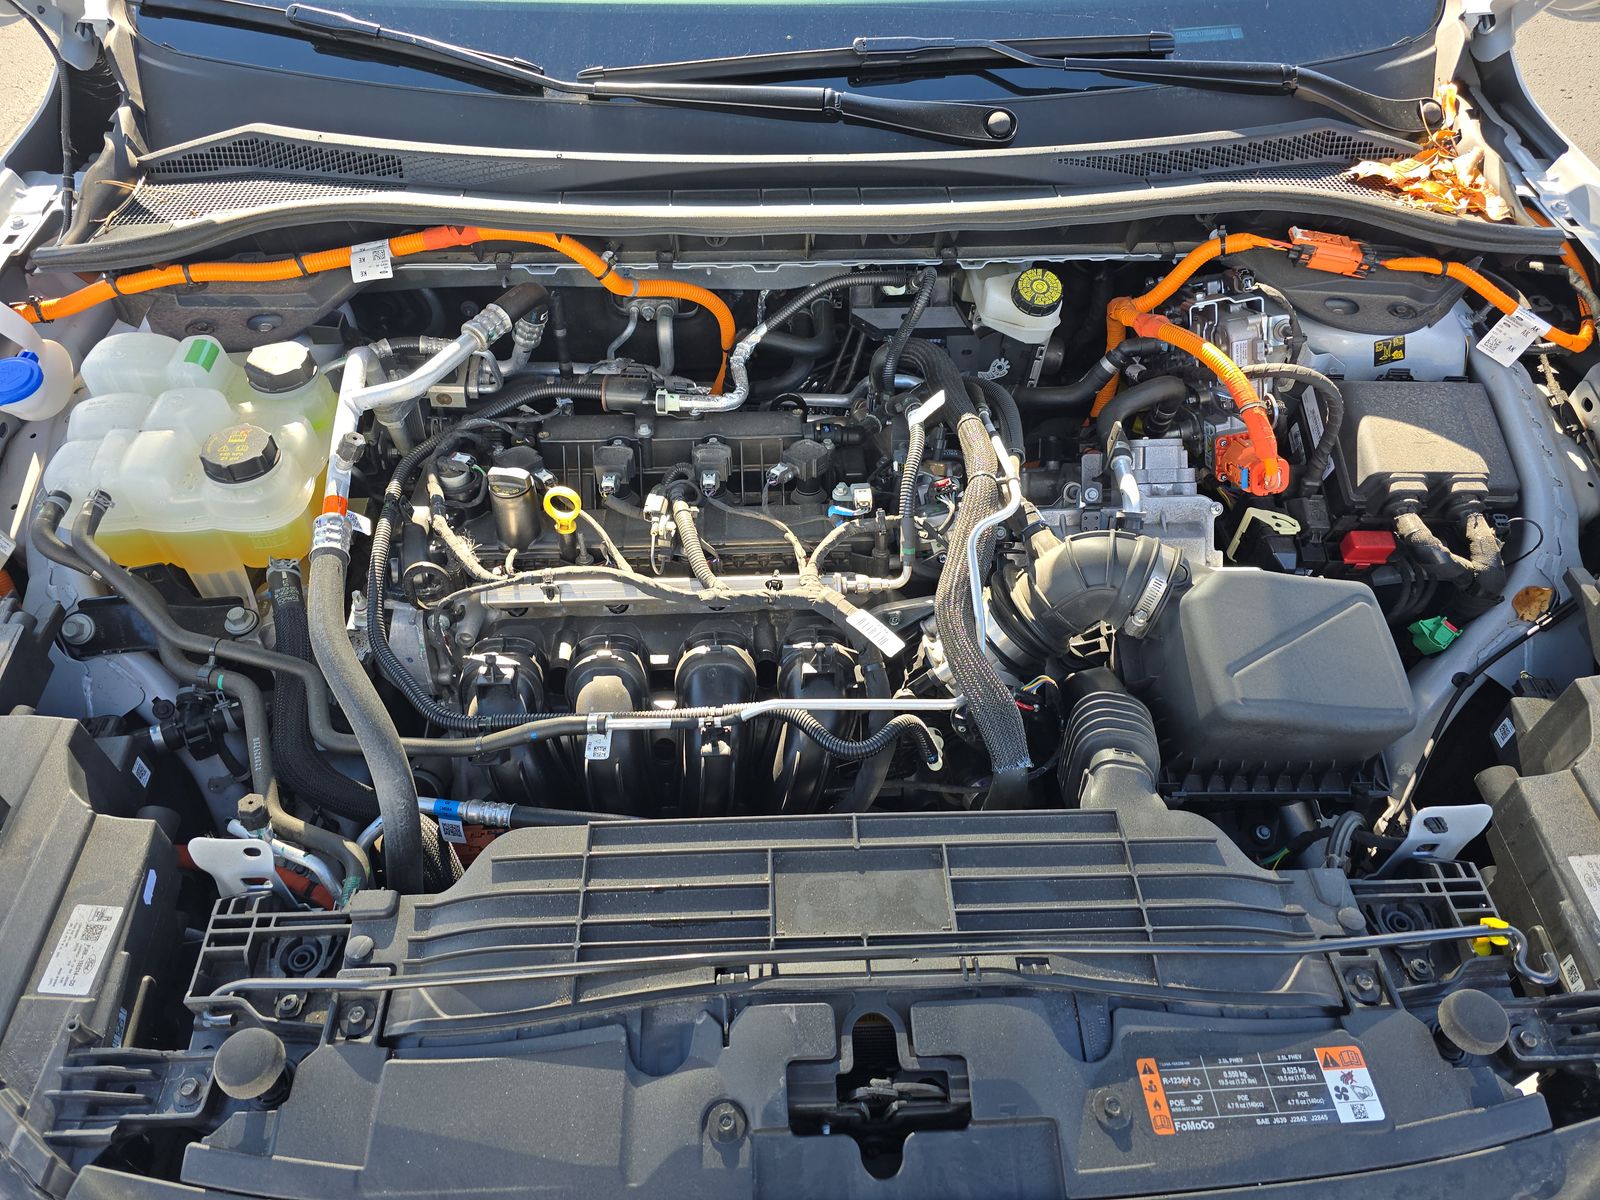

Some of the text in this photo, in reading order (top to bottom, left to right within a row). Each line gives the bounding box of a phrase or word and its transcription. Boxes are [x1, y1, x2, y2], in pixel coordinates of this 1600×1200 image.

[1239, 1070, 1248, 1079] kg
[1282, 1066, 1307, 1075] 0.525 kg
[1162, 1076, 1191, 1085] R-1234yf
[1169, 1099, 1186, 1107] POE
[1174, 1120, 1215, 1132] FoMoCo
